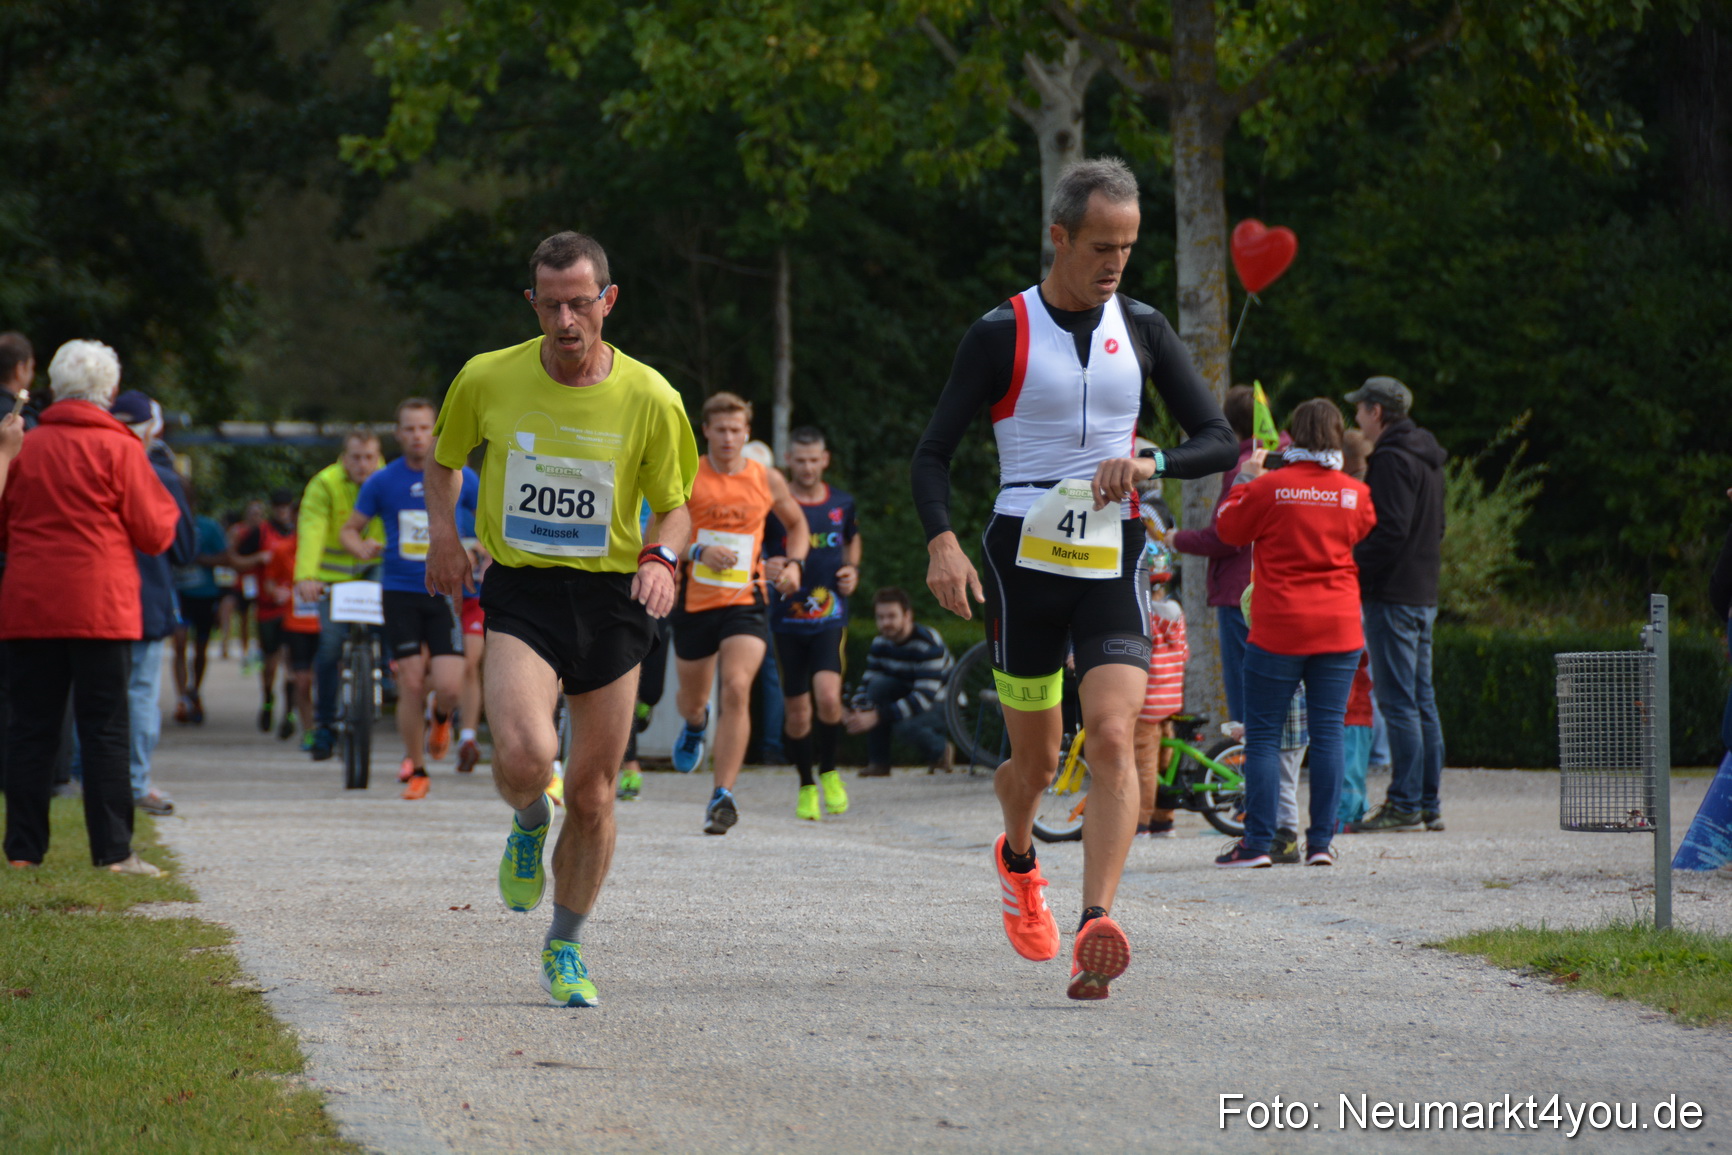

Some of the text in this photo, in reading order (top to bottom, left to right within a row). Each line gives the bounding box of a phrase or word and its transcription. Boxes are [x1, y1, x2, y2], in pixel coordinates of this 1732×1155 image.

[545, 465, 582, 477] BOCK
[519, 484, 595, 519] 2058
[1275, 486, 1339, 502] raumbox
[530, 524, 579, 539] Jezussek
[1056, 509, 1087, 539] 41
[1051, 546, 1090, 561] Markus
